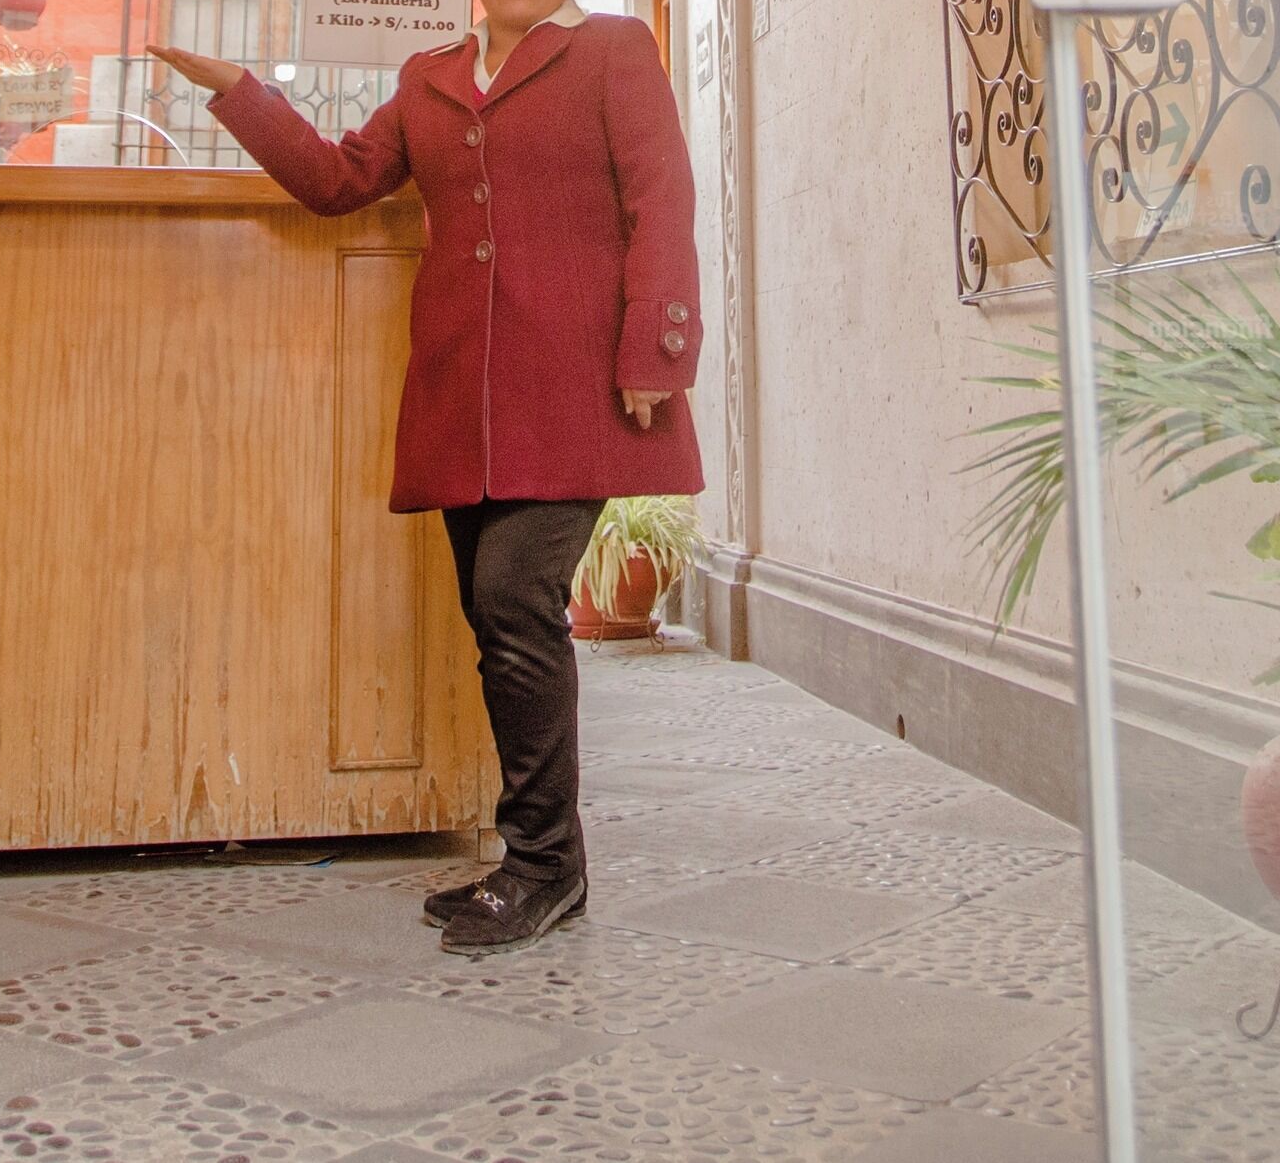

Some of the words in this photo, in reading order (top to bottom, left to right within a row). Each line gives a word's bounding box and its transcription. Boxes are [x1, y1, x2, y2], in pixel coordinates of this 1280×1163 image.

[315, 15, 323, 25] 1
[329, 13, 364, 27] Kilo
[385, 17, 408, 31] S/.
[413, 20, 455, 32] 10.00
[8, 100, 64, 116] SERVICE
